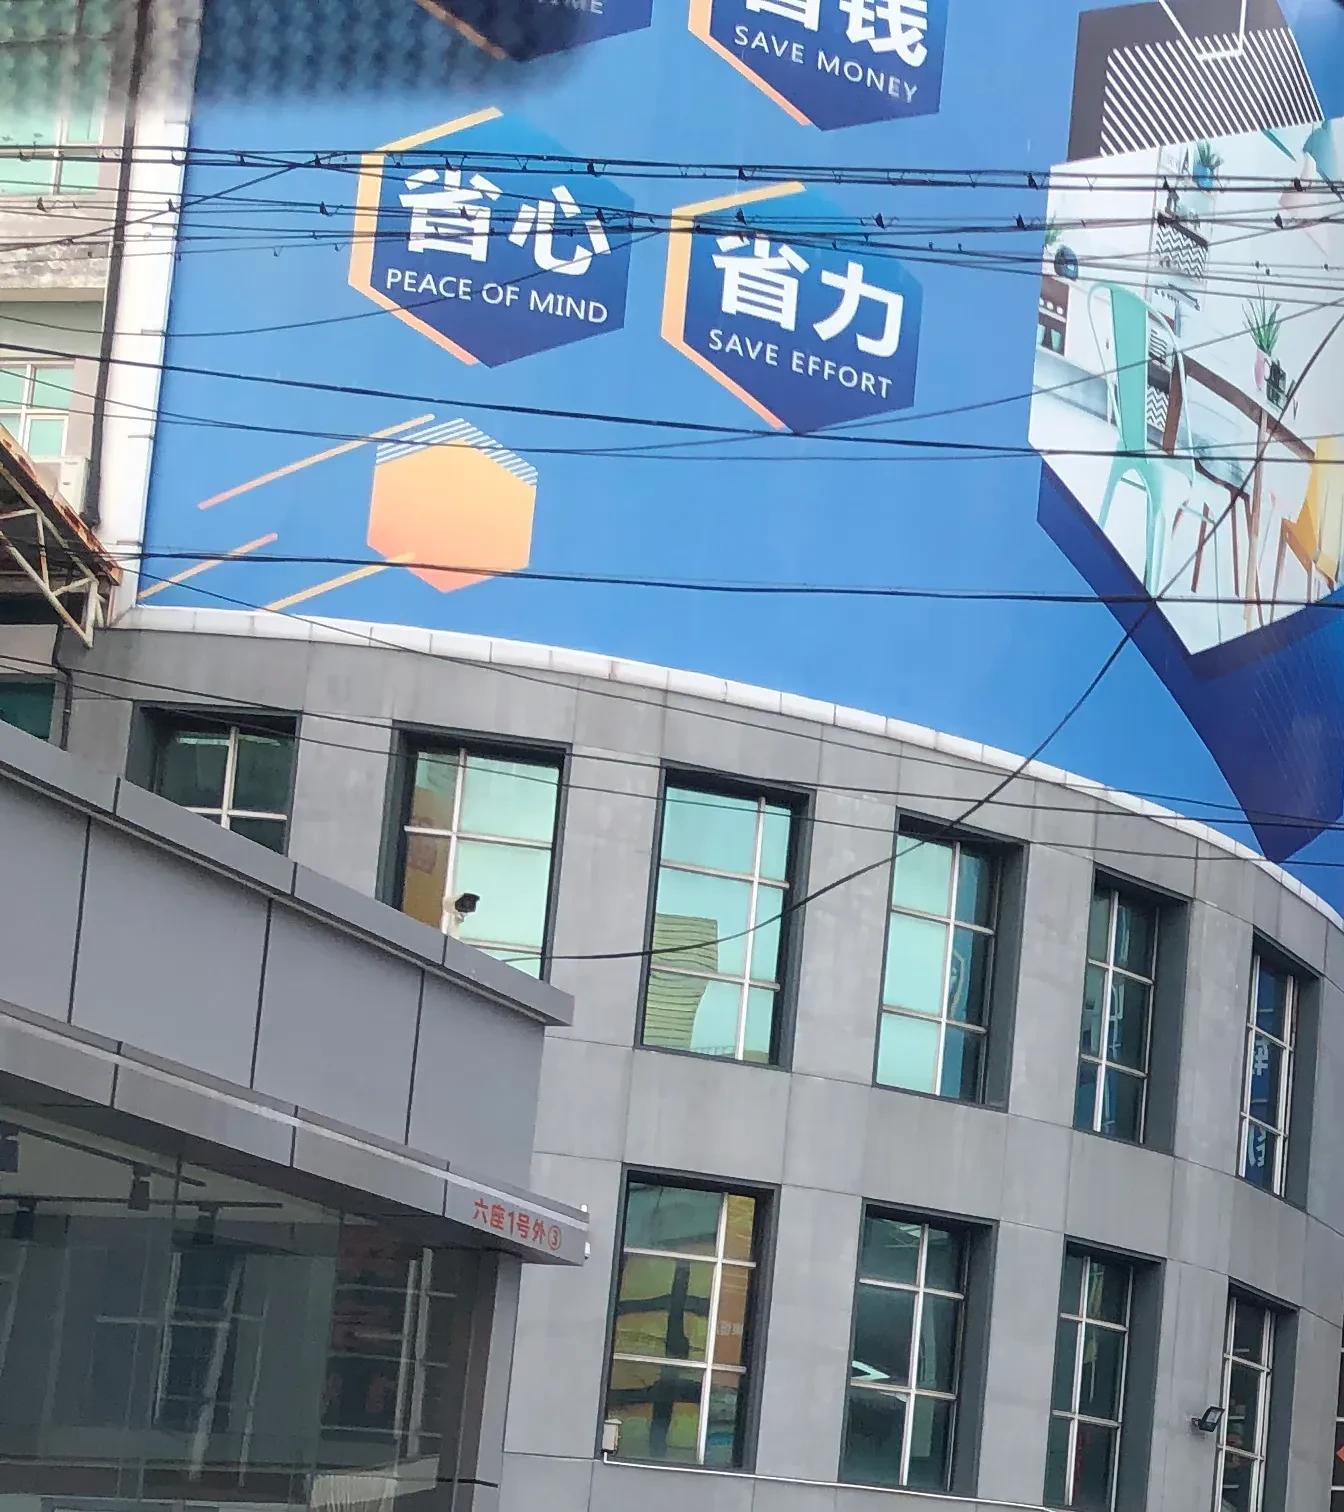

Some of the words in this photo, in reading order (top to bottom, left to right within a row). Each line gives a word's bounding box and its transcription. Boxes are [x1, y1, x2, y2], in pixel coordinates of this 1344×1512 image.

[734, 25, 806, 64] SAVE
[816, 51, 919, 105] MONEY
[399, 168, 611, 276] 省心
[386, 268, 471, 301] PEACE
[481, 283, 519, 307] OF
[528, 290, 608, 324] MIND
[712, 232, 905, 359] 省力
[708, 328, 778, 366] SAVE
[790, 351, 893, 399] EFFORT
